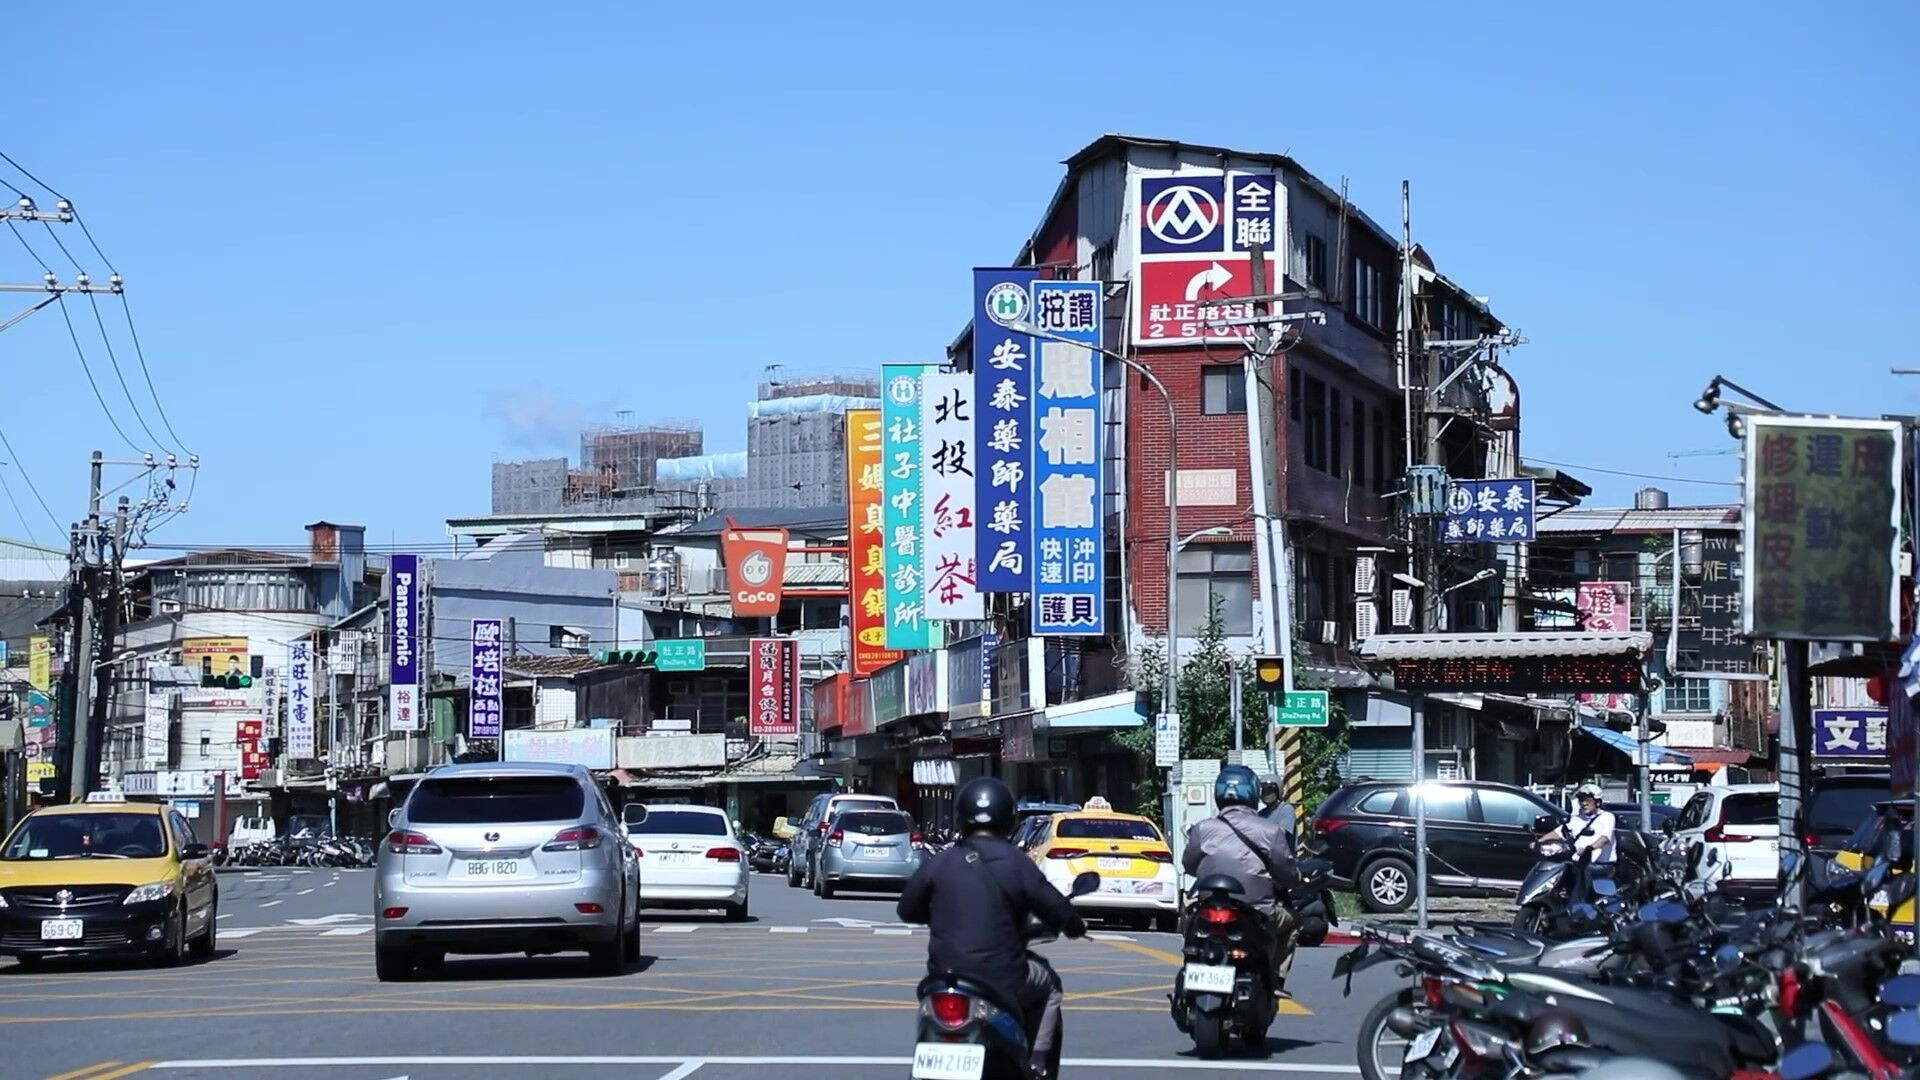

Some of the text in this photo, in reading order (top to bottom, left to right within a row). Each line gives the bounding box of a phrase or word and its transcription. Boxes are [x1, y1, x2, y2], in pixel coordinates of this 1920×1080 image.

[1236, 181, 1271, 248] 全聯
[987, 338, 1027, 575] 安泰藥師藥局
[1038, 342, 1096, 529] 照相館
[887, 416, 924, 632] 社子中醫診所
[928, 388, 975, 605] 北投紅茶
[1473, 485, 1530, 512] 安泰
[1444, 517, 1528, 538] 藥師藥局
[1040, 537, 1063, 584] 快速
[1073, 537, 1095, 584] 沖印
[396, 572, 412, 667] Panasonic
[737, 590, 776, 604] CoCo
[1041, 595, 1095, 624] 護貝
